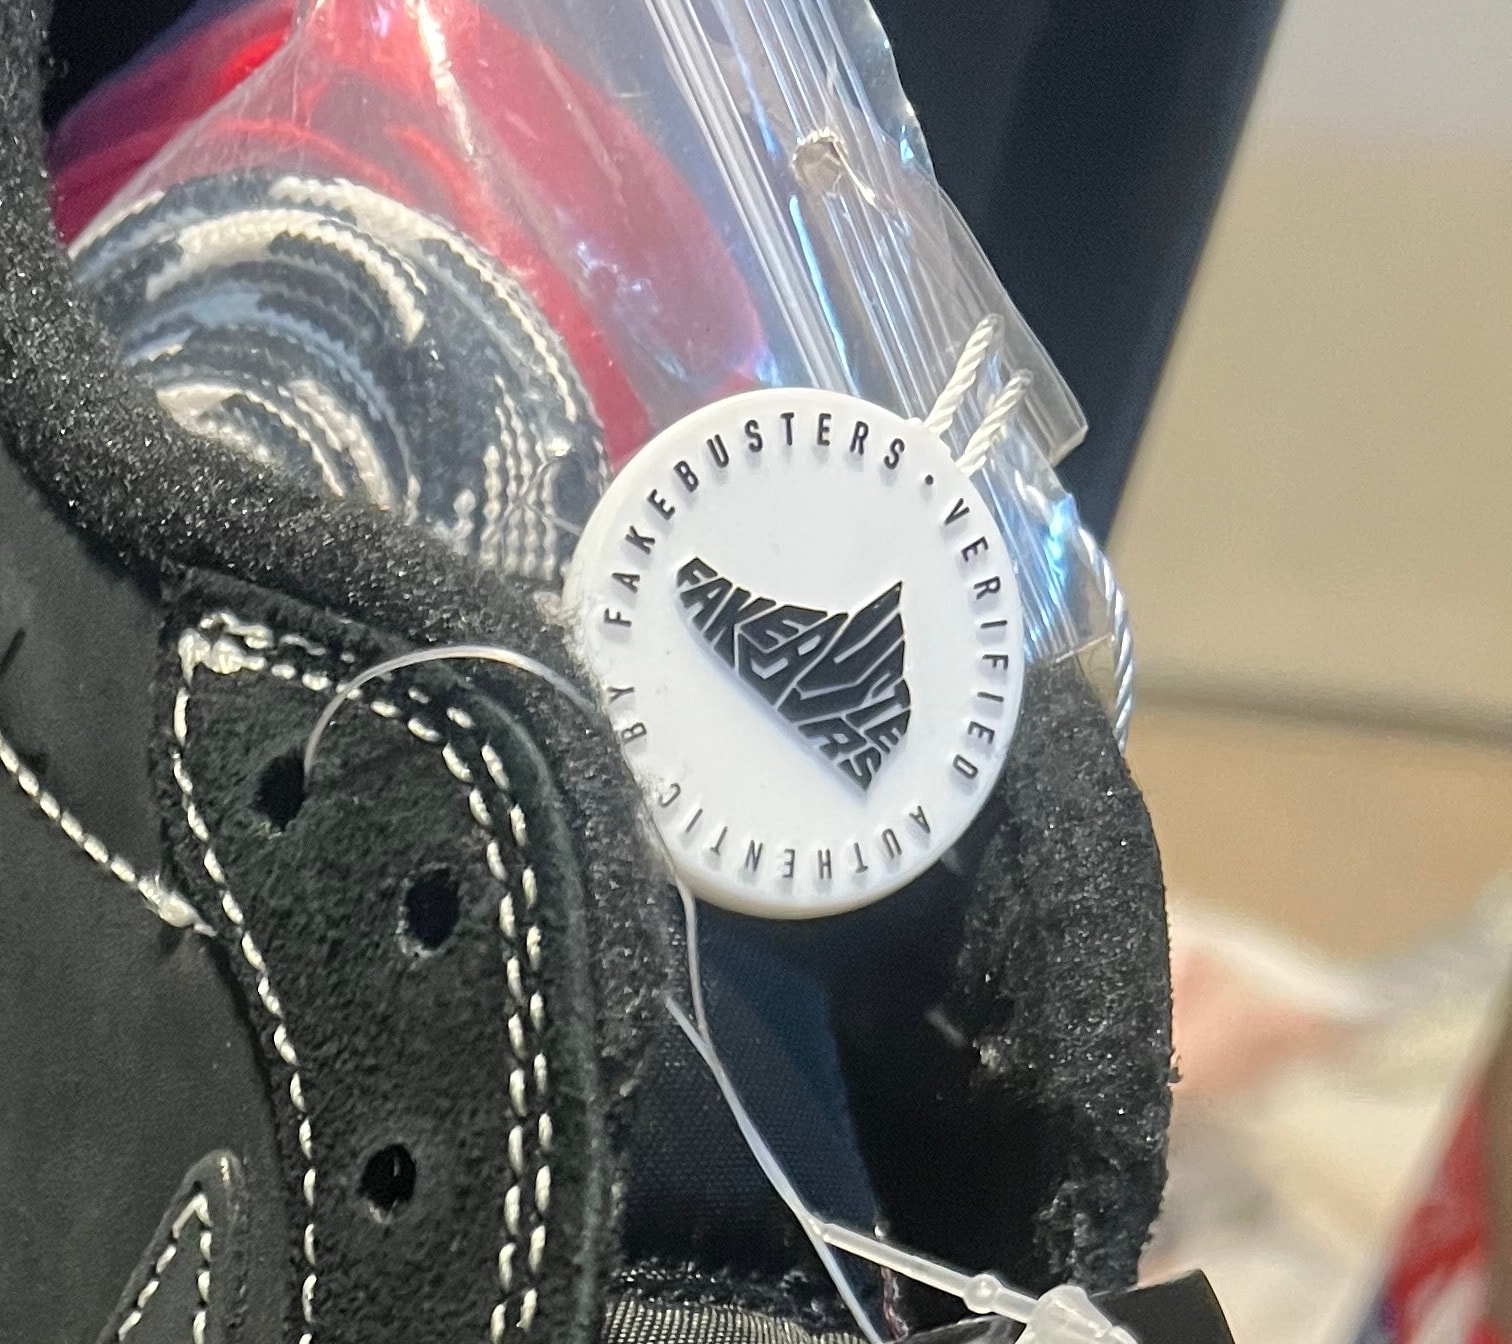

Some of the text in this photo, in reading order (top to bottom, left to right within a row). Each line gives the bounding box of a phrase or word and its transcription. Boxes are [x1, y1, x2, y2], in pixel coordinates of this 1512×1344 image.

[605, 412, 1008, 877] VERIFIED AUTHENTIC BY FAKEBUSTERS
